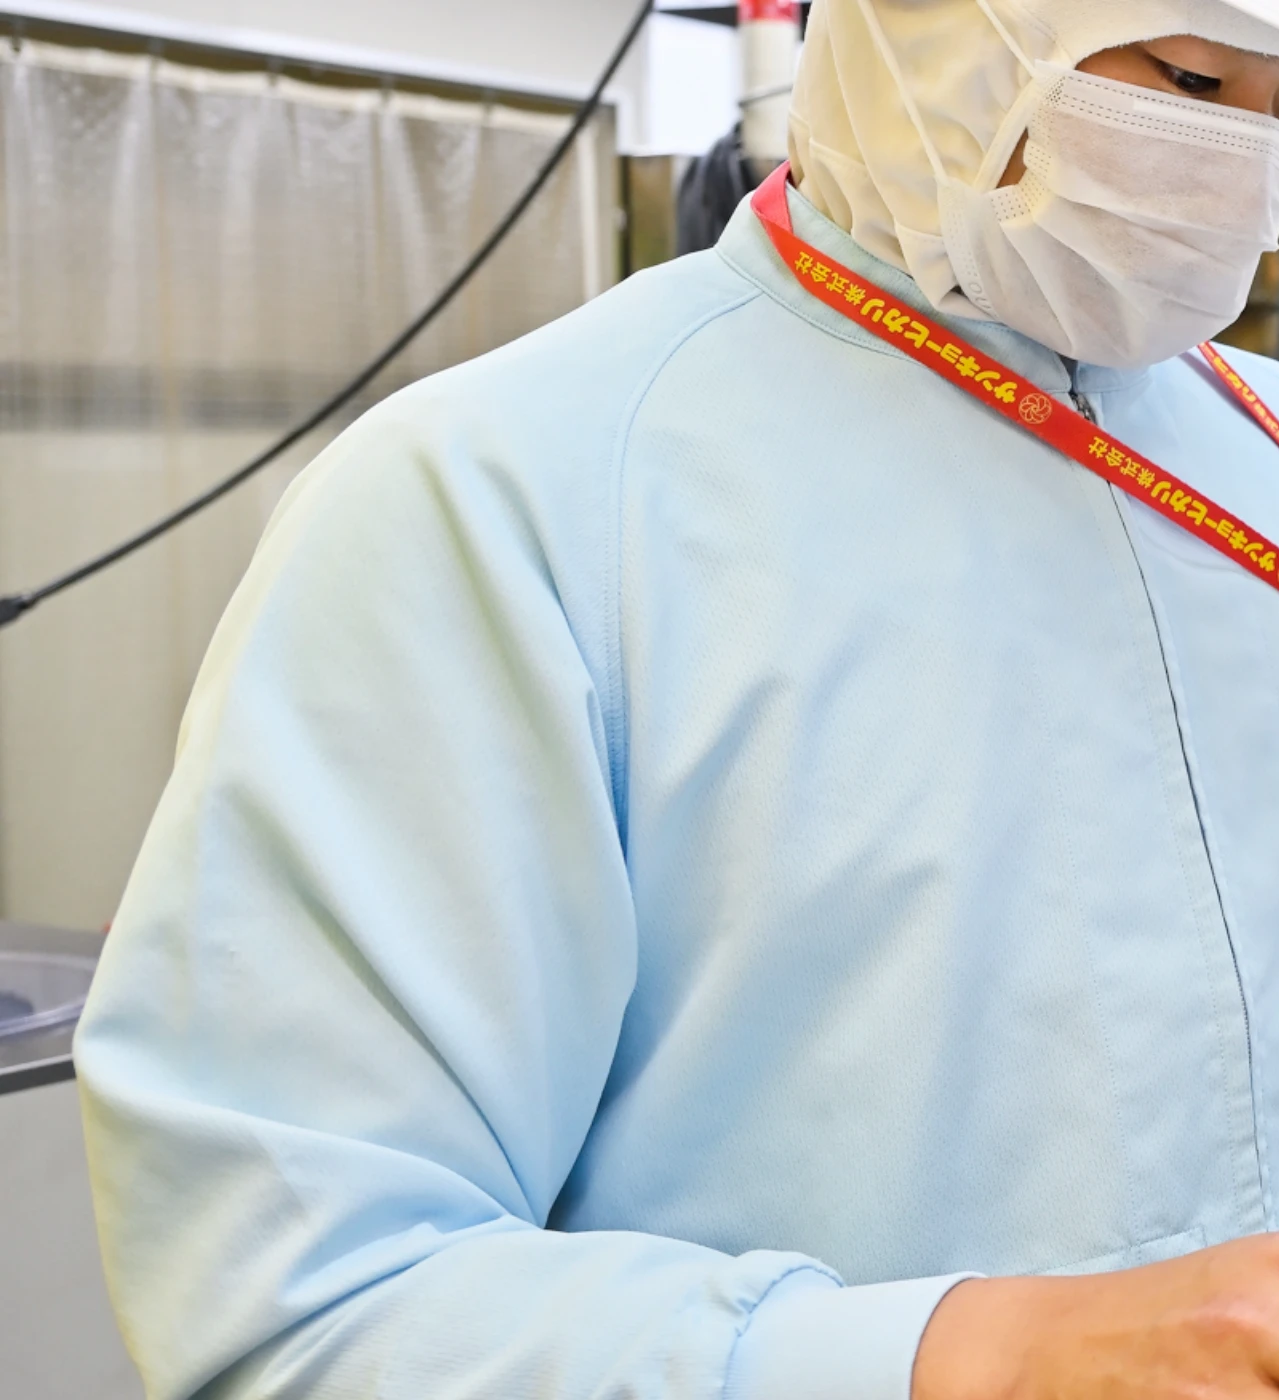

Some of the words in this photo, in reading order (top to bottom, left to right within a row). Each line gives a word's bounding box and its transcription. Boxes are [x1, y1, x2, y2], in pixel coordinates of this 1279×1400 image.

[794, 251, 1018, 404] サンキョーヒカリ株式会社
[1088, 436, 1277, 572] サンキョーヒカリ株式会社
